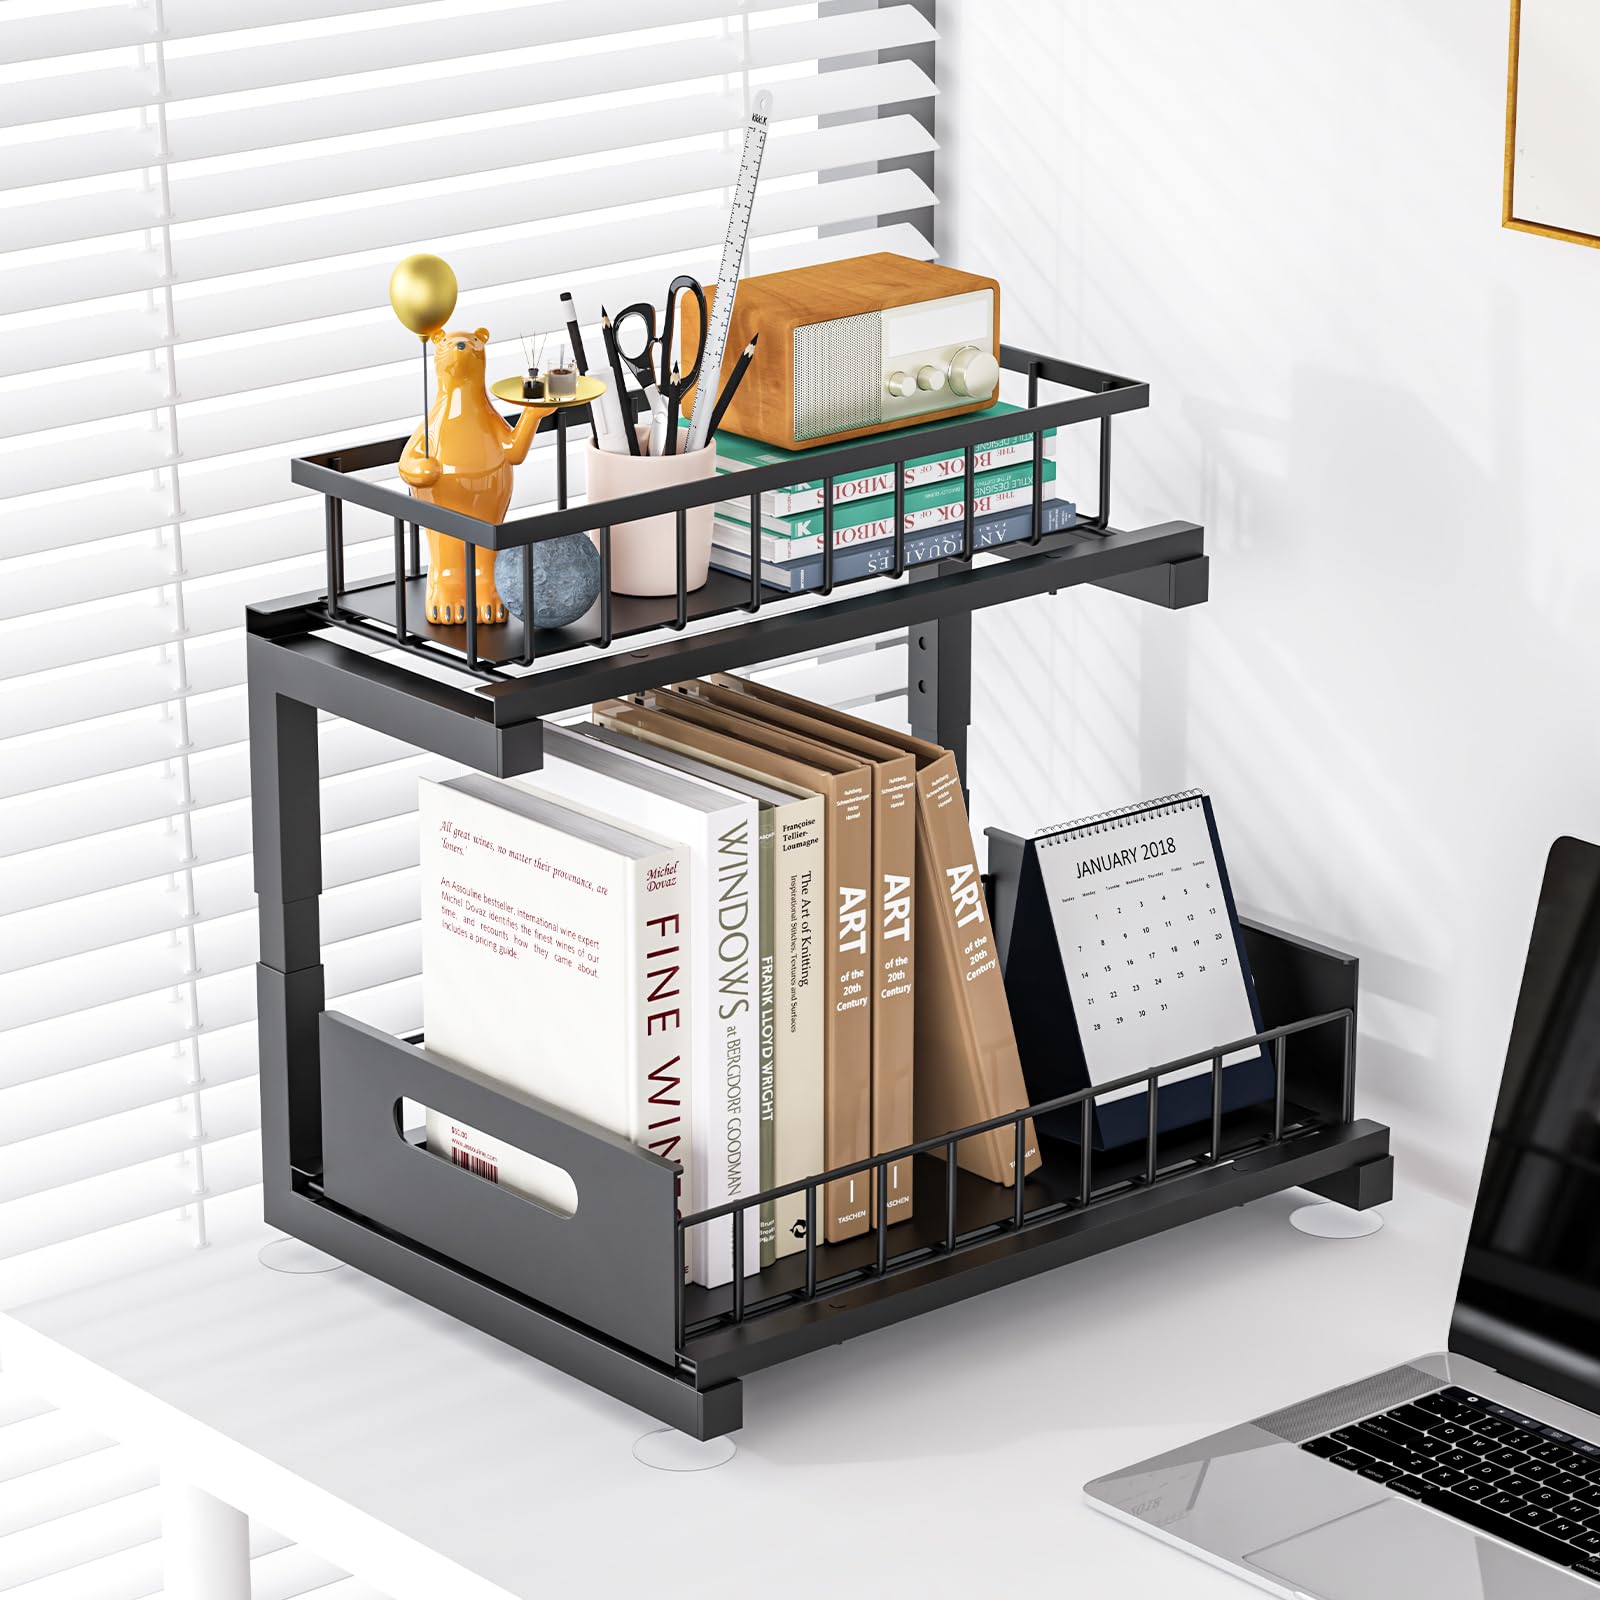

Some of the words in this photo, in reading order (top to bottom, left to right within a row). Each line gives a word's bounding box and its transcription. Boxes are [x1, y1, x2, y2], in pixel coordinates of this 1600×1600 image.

[938, 451, 991, 477] BOK
[997, 446, 1015, 456] THE
[920, 466, 932, 475] OF
[817, 469, 915, 503] SMBOLS
[996, 491, 1015, 500] THE
[920, 510, 932, 519] OF
[937, 496, 991, 522] BOK
[817, 514, 915, 549] SMBOLS
[868, 529, 1007, 572] ANIQUAIES
[782, 819, 816, 832] Françoise
[782, 830, 809, 842] Tellier-
[440, 821, 453, 833] All
[453, 828, 470, 840] great
[473, 836, 495, 852] wines,
[498, 846, 507, 855] no
[508, 850, 532, 865] matter
[534, 858, 551, 872] their
[552, 867, 594, 891] provenance,
[597, 885, 609, 896] are
[782, 837, 819, 852] Loumagne
[1076, 847, 1138, 879] JANUARY
[1140, 837, 1177, 861] 2018
[646, 860, 680, 881] Michel
[646, 876, 677, 893] Dovaz
[801, 870, 812, 895] The
[789, 874, 798, 922] Inspirational
[801, 899, 812, 919] Art
[883, 874, 911, 942] ART
[946, 863, 985, 928] ART
[1116, 907, 1122, 915] 2
[1139, 900, 1144, 908] 3
[1183, 888, 1188, 896] 5
[441, 876, 451, 888] An
[452, 881, 482, 901] Assouline
[517, 907, 559, 933] international
[560, 926, 577, 940] wine
[578, 934, 599, 949] expert
[717, 818, 749, 1020] WINDOWS
[839, 886, 867, 955] ART
[442, 891, 463, 907] Michel
[465, 900, 486, 917] Dovaz
[489, 910, 519, 931] identifies
[521, 924, 531, 936] the
[535, 929, 553, 945] finest
[555, 940, 575, 954] wines
[577, 948, 585, 958] of
[588, 953, 599, 964] our
[442, 919, 468, 938] Includes
[469, 932, 474, 941] a
[475, 935, 497, 953] pricing
[801, 921, 812, 933] of
[1077, 945, 1082, 953] 7
[1142, 926, 1150, 934] 10
[1164, 920, 1172, 928] 11
[1186, 913, 1195, 922] 12
[1208, 907, 1217, 915] 13
[462, 916, 475, 927] and
[480, 923, 509, 941] recounts
[514, 934, 529, 949] how
[534, 943, 549, 960] they
[554, 954, 573, 967] came
[964, 943, 973, 955] of
[974, 935, 988, 948] the
[1081, 971, 1089, 979] 14
[1103, 964, 1112, 973] 15
[1126, 958, 1134, 966] 16
[1148, 951, 1156, 959] 17
[1170, 945, 1178, 953] 18
[1192, 939, 1200, 947] 19
[1214, 932, 1223, 941] 20
[790, 953, 798, 986] Textures
[798, 936, 812, 987] Knitting
[884, 959, 894, 970] of
[895, 956, 909, 967] the
[966, 958, 996, 982] Century
[969, 949, 988, 966] 20th
[646, 913, 680, 1036] FINE
[761, 955, 774, 1007] FRANK
[840, 972, 850, 983] of
[850, 969, 864, 979] the
[887, 970, 906, 983] 20th
[1087, 997, 1095, 1005] 21
[1109, 990, 1118, 999] 22
[1132, 984, 1140, 992] 23
[1154, 977, 1162, 986] 24
[1176, 970, 1185, 979] 25
[1198, 964, 1206, 973] 26
[1220, 957, 1228, 966] 27
[790, 987, 798, 1001] and
[836, 995, 868, 1012] Century
[843, 983, 861, 996] 20th
[881, 982, 911, 999] Century
[726, 1025, 736, 1037] at
[790, 1002, 798, 1033] Surfaces
[1093, 1023, 1101, 1032] 28
[1115, 1016, 1124, 1025] 29
[1138, 1009, 1146, 1018] 30
[1160, 1003, 1168, 1011] 31
[761, 1009, 774, 1058] LLOYD
[726, 1038, 742, 1115] BERGDORF
[761, 1062, 774, 1121] WRIGHT
[647, 1055, 681, 1220] WIN
[726, 1117, 742, 1197] GOODMAN
[886, 1195, 909, 1208] ASCHEN
[837, 1209, 866, 1224] TASCHEN
